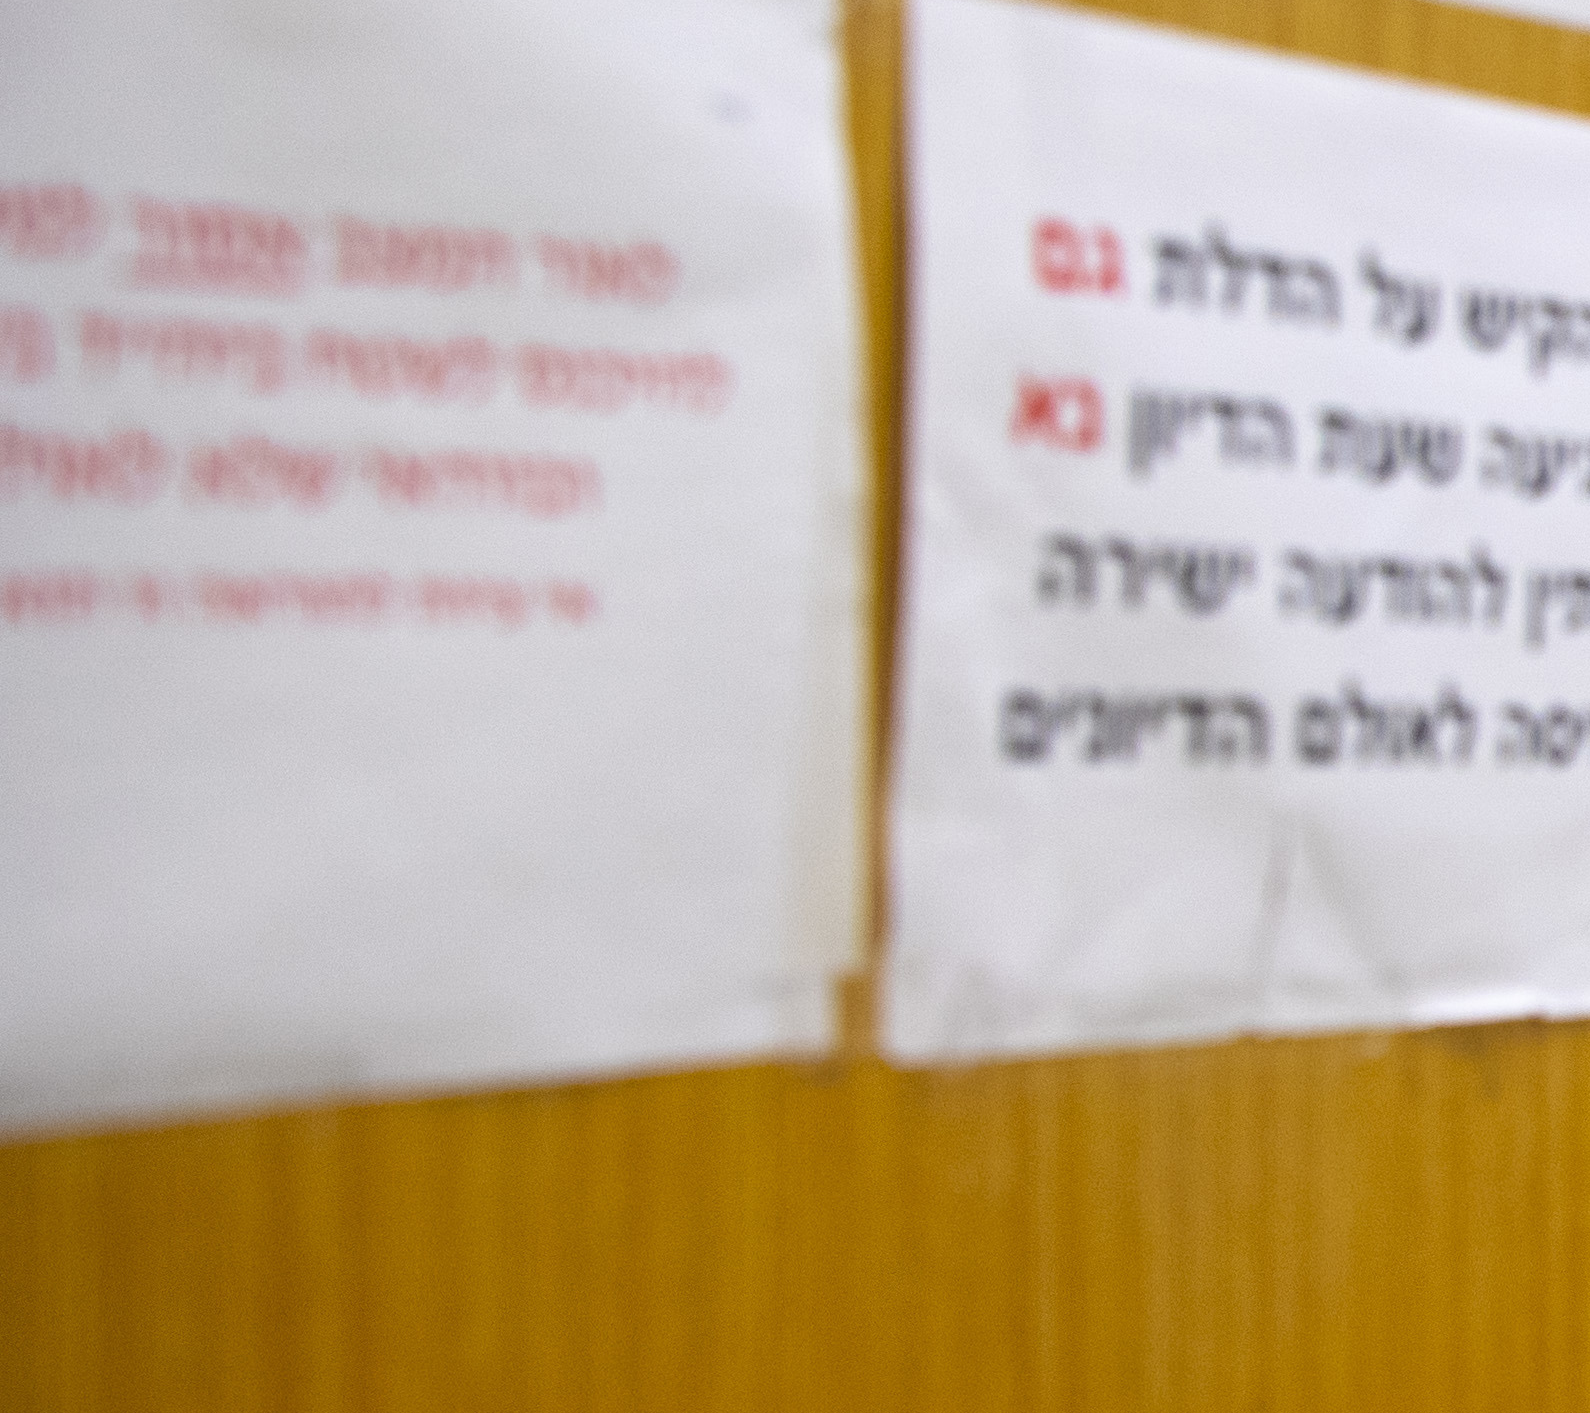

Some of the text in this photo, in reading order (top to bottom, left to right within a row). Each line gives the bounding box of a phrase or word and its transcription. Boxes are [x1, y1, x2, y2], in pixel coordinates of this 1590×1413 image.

[1033, 216, 1126, 297] גם
[1153, 224, 1342, 332] הדלת
[1358, 239, 1440, 346] על
[1128, 384, 1293, 480] הדיון
[1319, 408, 1463, 487] שעת
[1037, 533, 1254, 618] ישירה
[1282, 542, 1509, 626] להודעה
[1000, 688, 1271, 766] הדיונים
[1295, 681, 1478, 768] לאולם
